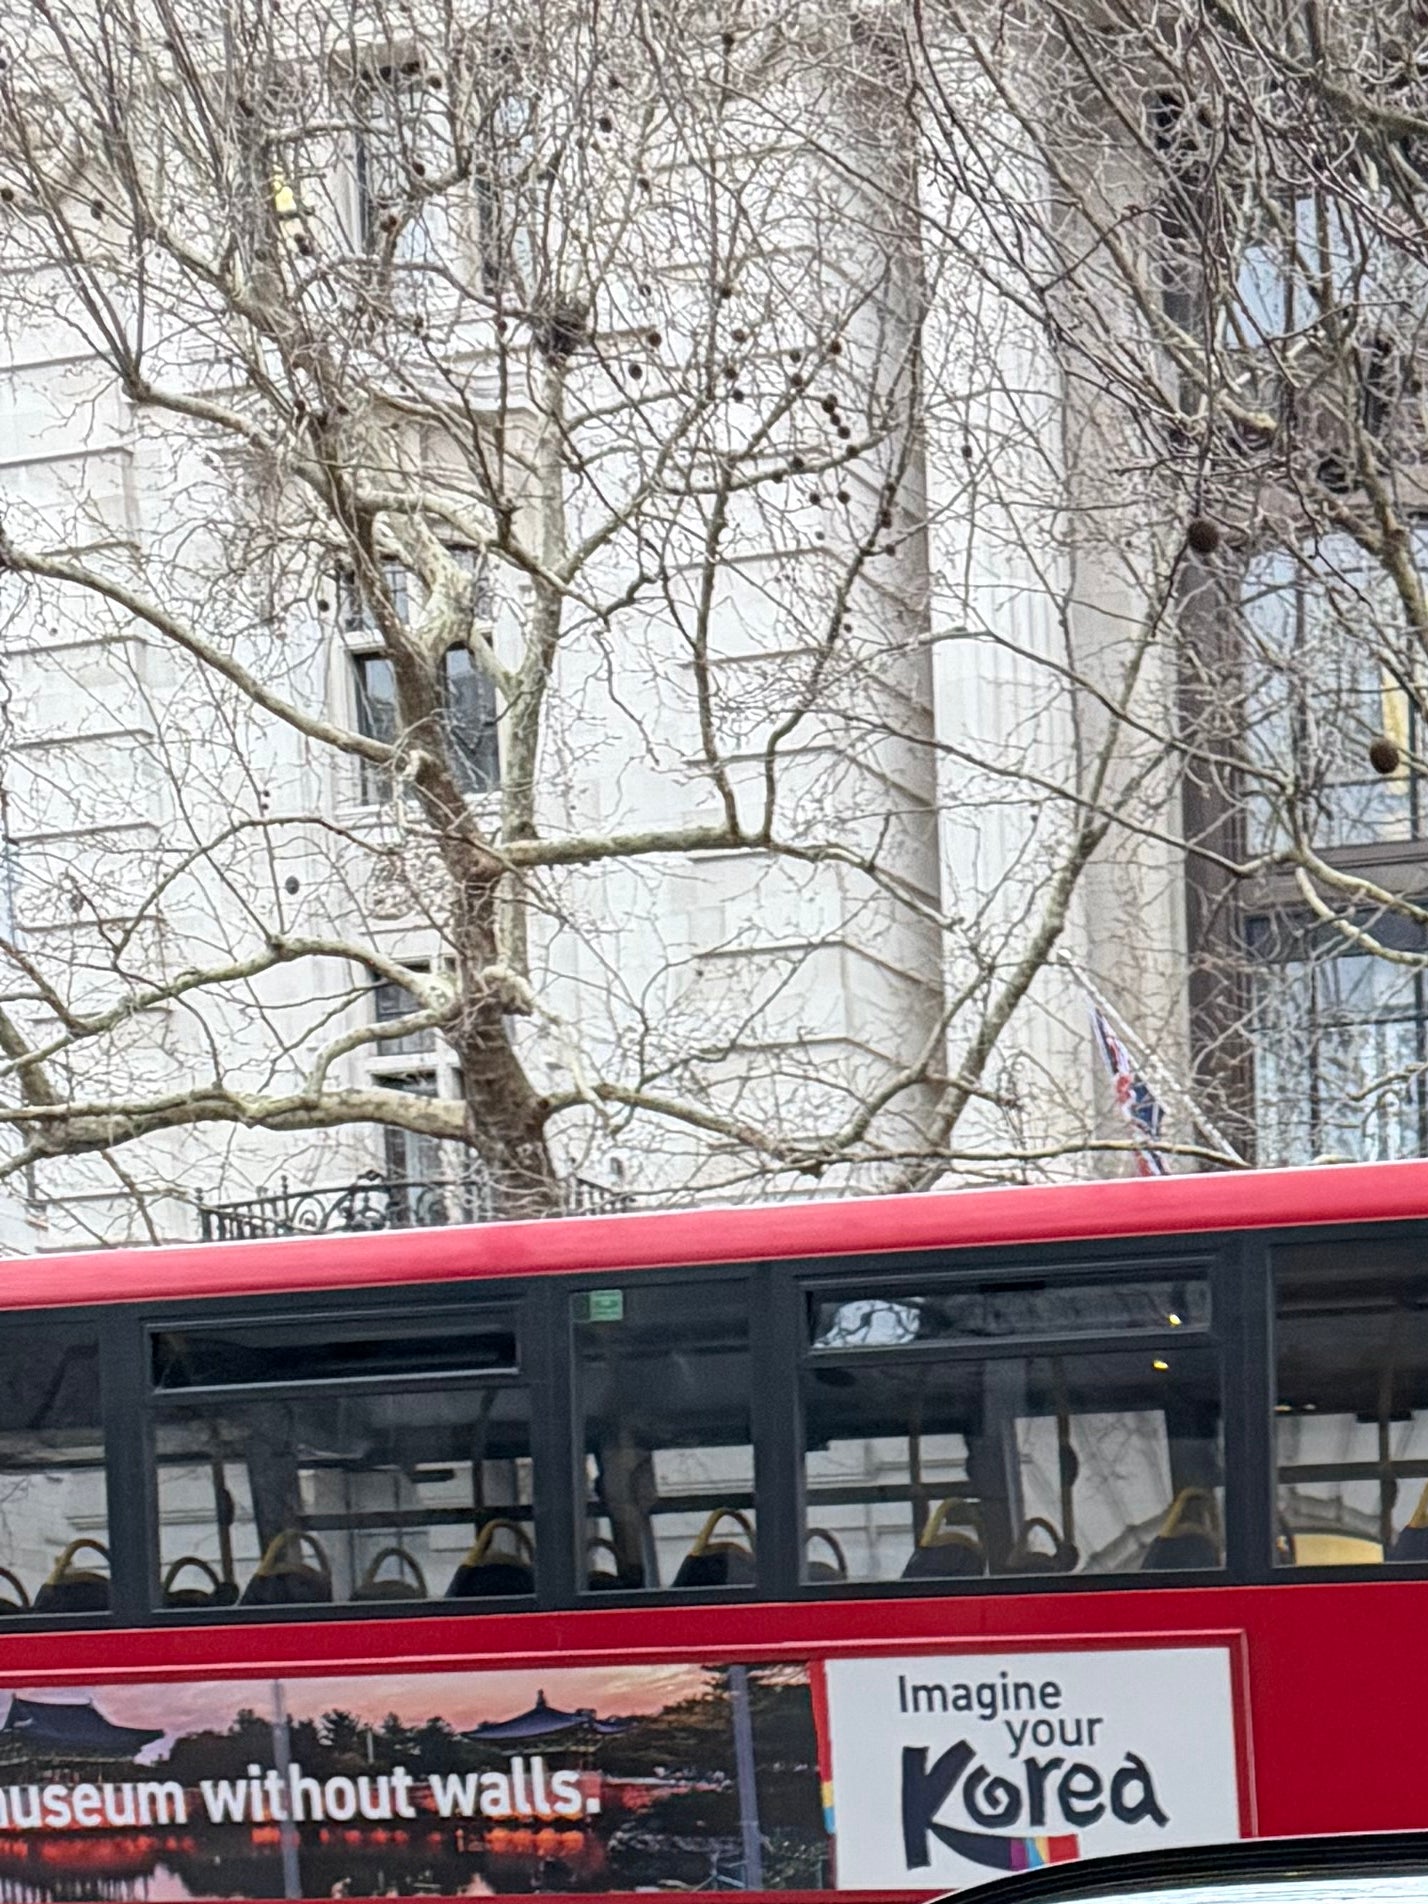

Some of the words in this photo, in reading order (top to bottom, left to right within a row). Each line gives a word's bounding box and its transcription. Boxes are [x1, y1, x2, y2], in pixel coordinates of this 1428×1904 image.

[898, 1671, 1062, 1721] Imagine
[1004, 1716, 1104, 1759] your
[200, 1762, 417, 1823] without
[428, 1756, 602, 1817] walls.
[901, 1739, 1170, 1871] Korea
